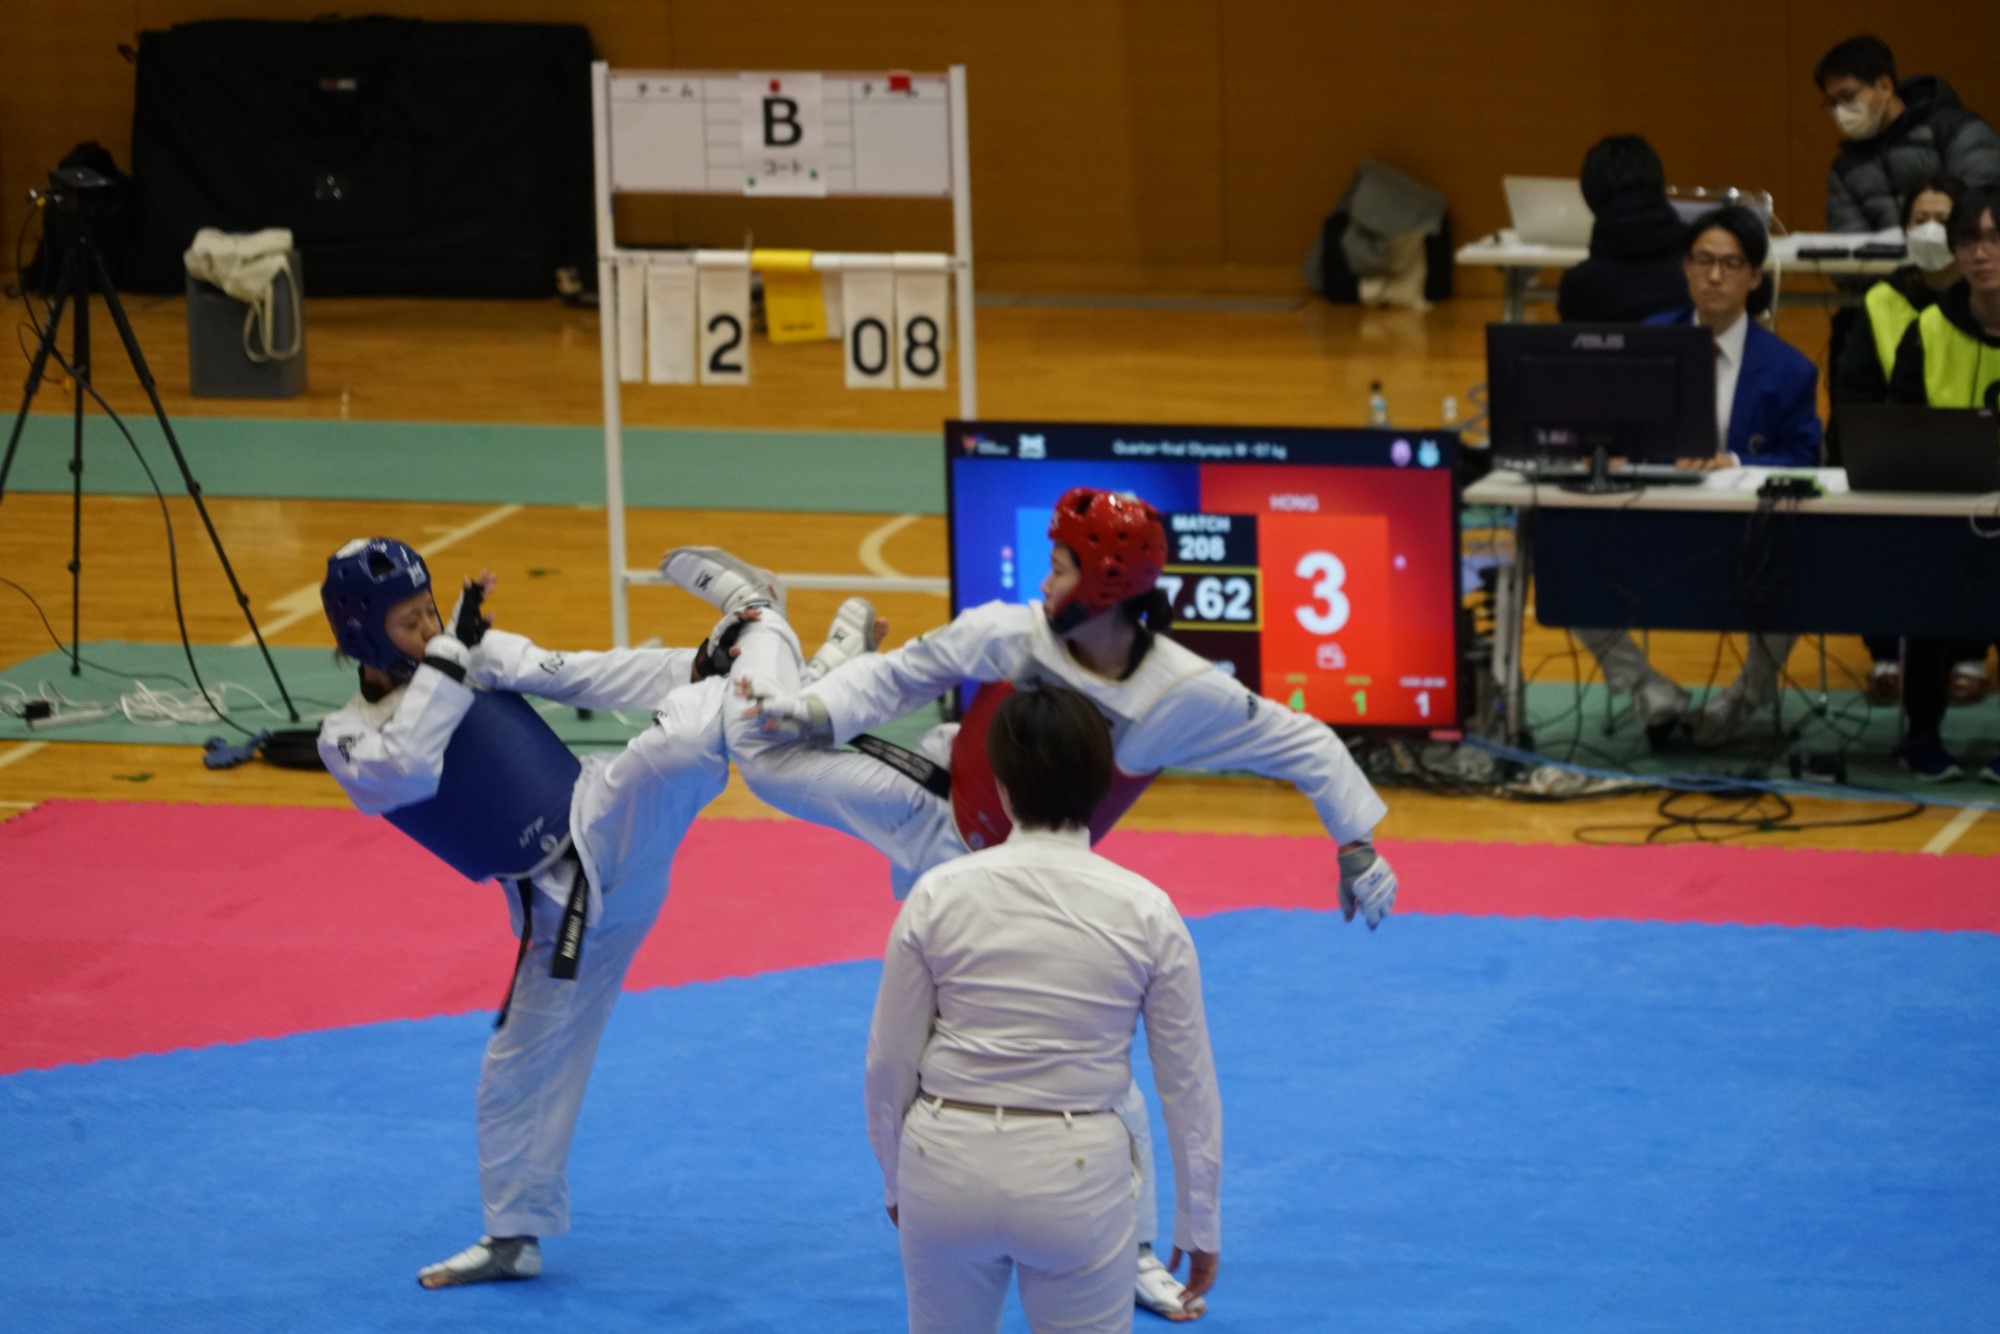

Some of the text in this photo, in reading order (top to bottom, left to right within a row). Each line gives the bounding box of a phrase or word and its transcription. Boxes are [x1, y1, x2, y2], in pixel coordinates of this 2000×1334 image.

[762, 96, 804, 148] B
[763, 160, 801, 175] コート
[708, 315, 743, 374] 2
[1269, 494, 1320, 512] HONG
[1171, 515, 1231, 533] MATCH
[1178, 535, 1226, 562] 208
[1295, 551, 1351, 636] 3
[1352, 689, 1367, 716] 1
[1415, 690, 1431, 718] 1
